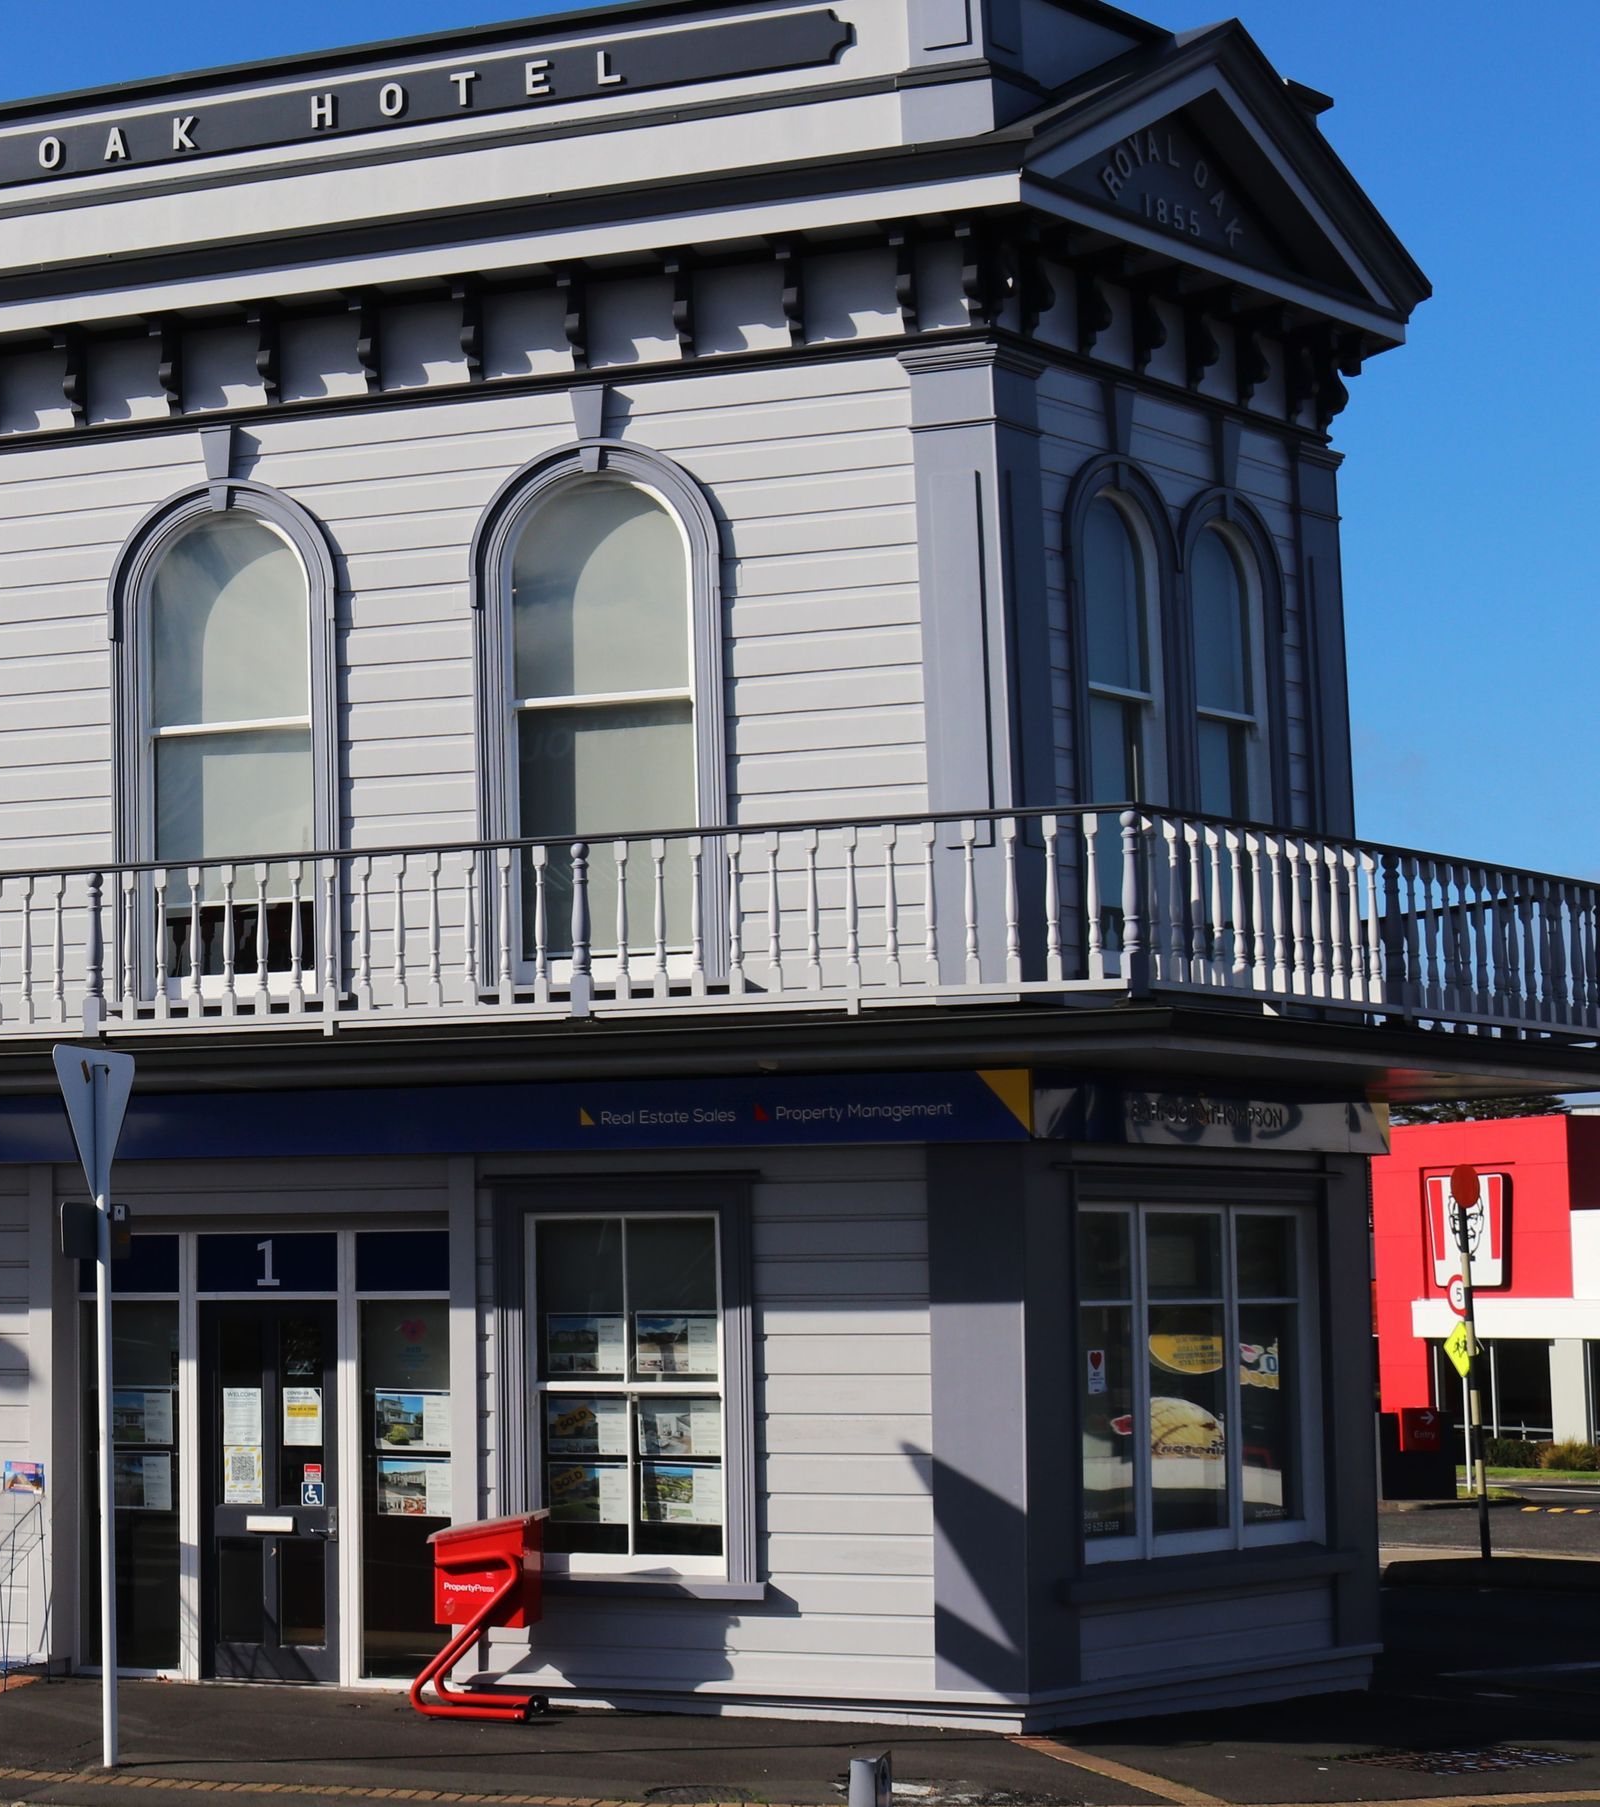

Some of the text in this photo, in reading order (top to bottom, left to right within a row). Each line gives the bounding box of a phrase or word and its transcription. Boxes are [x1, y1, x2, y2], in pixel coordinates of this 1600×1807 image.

[38, 116, 198, 169] OAK
[310, 51, 622, 130] HOTEL
[1102, 129, 1244, 249] ROYAL OAK
[1145, 193, 1200, 236] 1855
[601, 1108, 736, 1126] Real Estate Sales
[776, 1102, 952, 1123] Property Management
[257, 1239, 280, 1286] 1
[560, 1410, 587, 1429] SOLD
[1414, 1430, 1435, 1440] Entry
[555, 1471, 583, 1489] SOLD
[443, 1582, 495, 1593] PropertyPress
